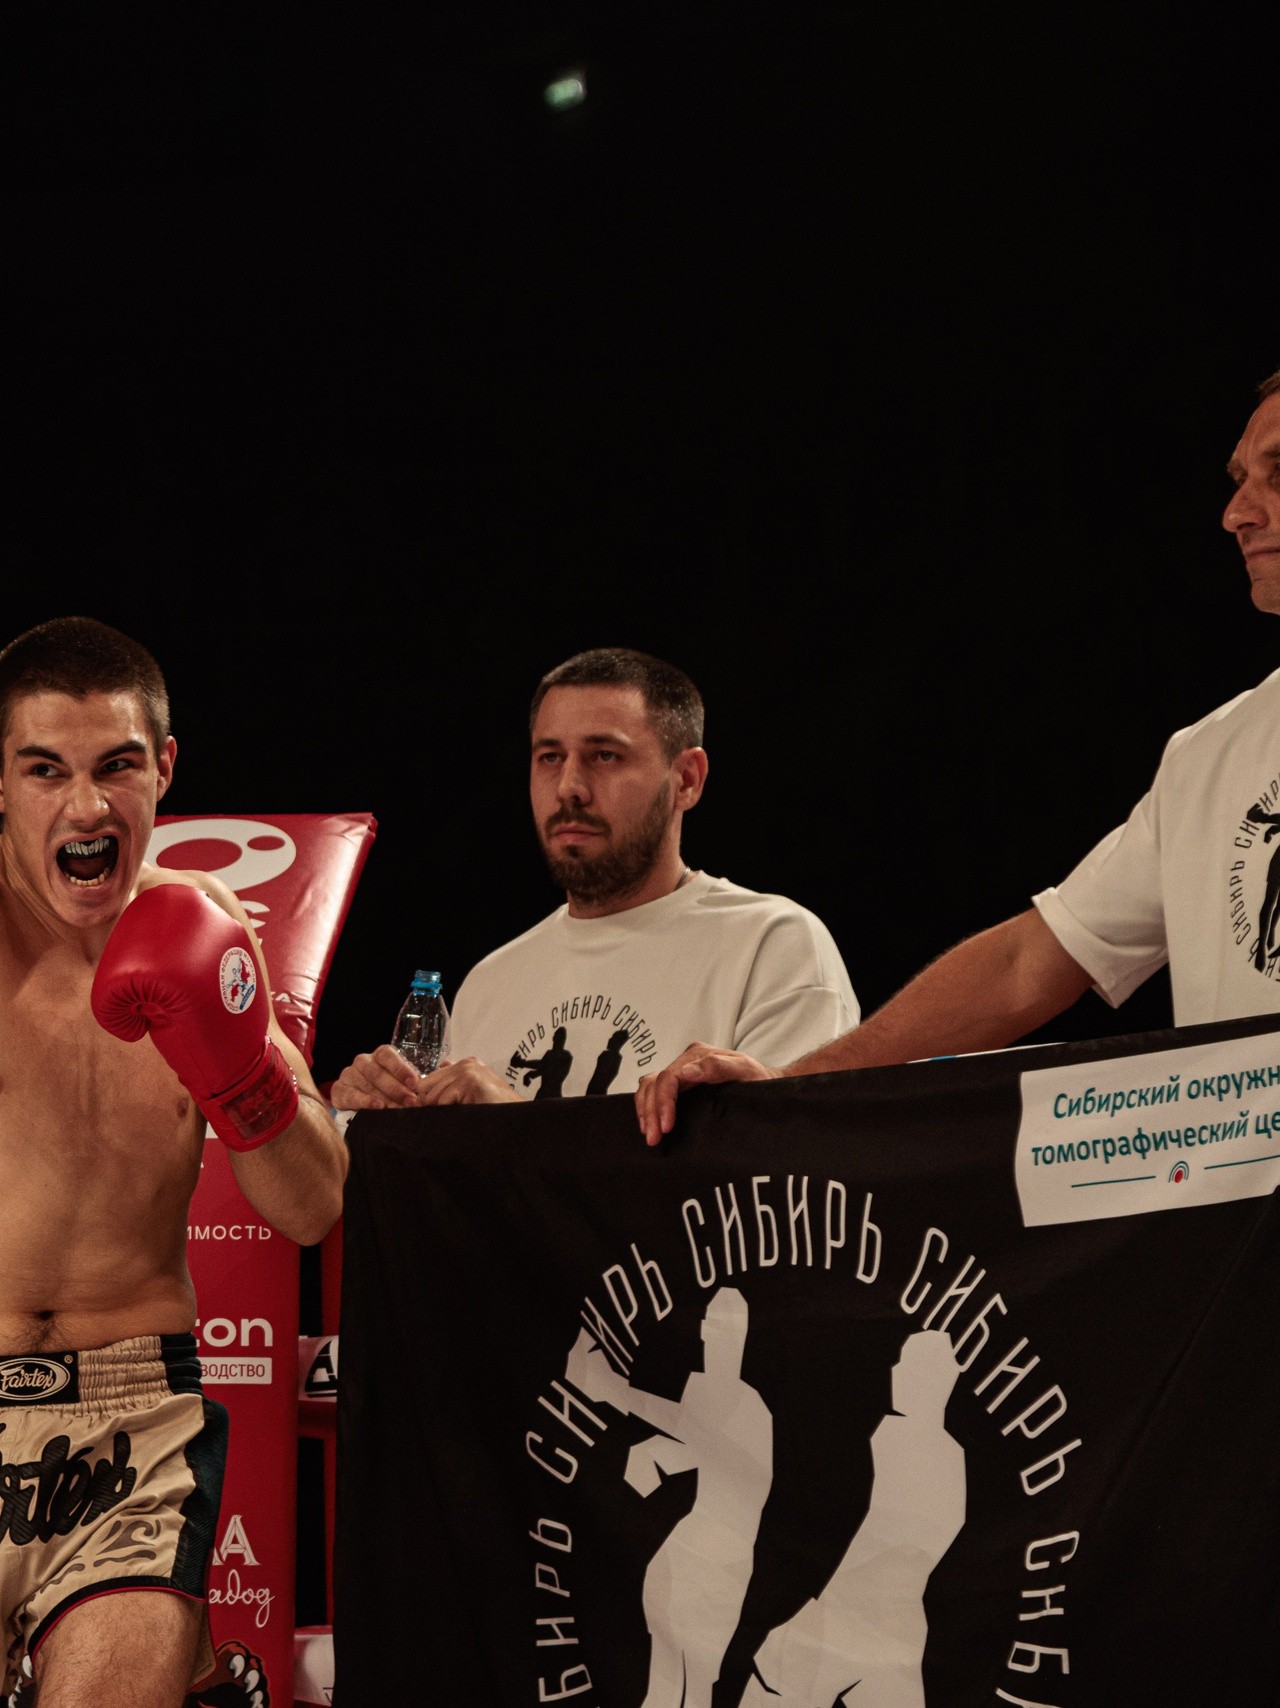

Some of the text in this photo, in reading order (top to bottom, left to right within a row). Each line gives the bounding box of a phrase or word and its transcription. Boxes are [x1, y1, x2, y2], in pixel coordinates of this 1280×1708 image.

[551, 995, 612, 1029] СИБИРЬ
[1053, 1074, 1181, 1119] Сибирский
[1031, 1110, 1251, 1166] томографический
[682, 1175, 882, 1288] СИБИРЬ
[0, 1364, 54, 1392] Fairtex
